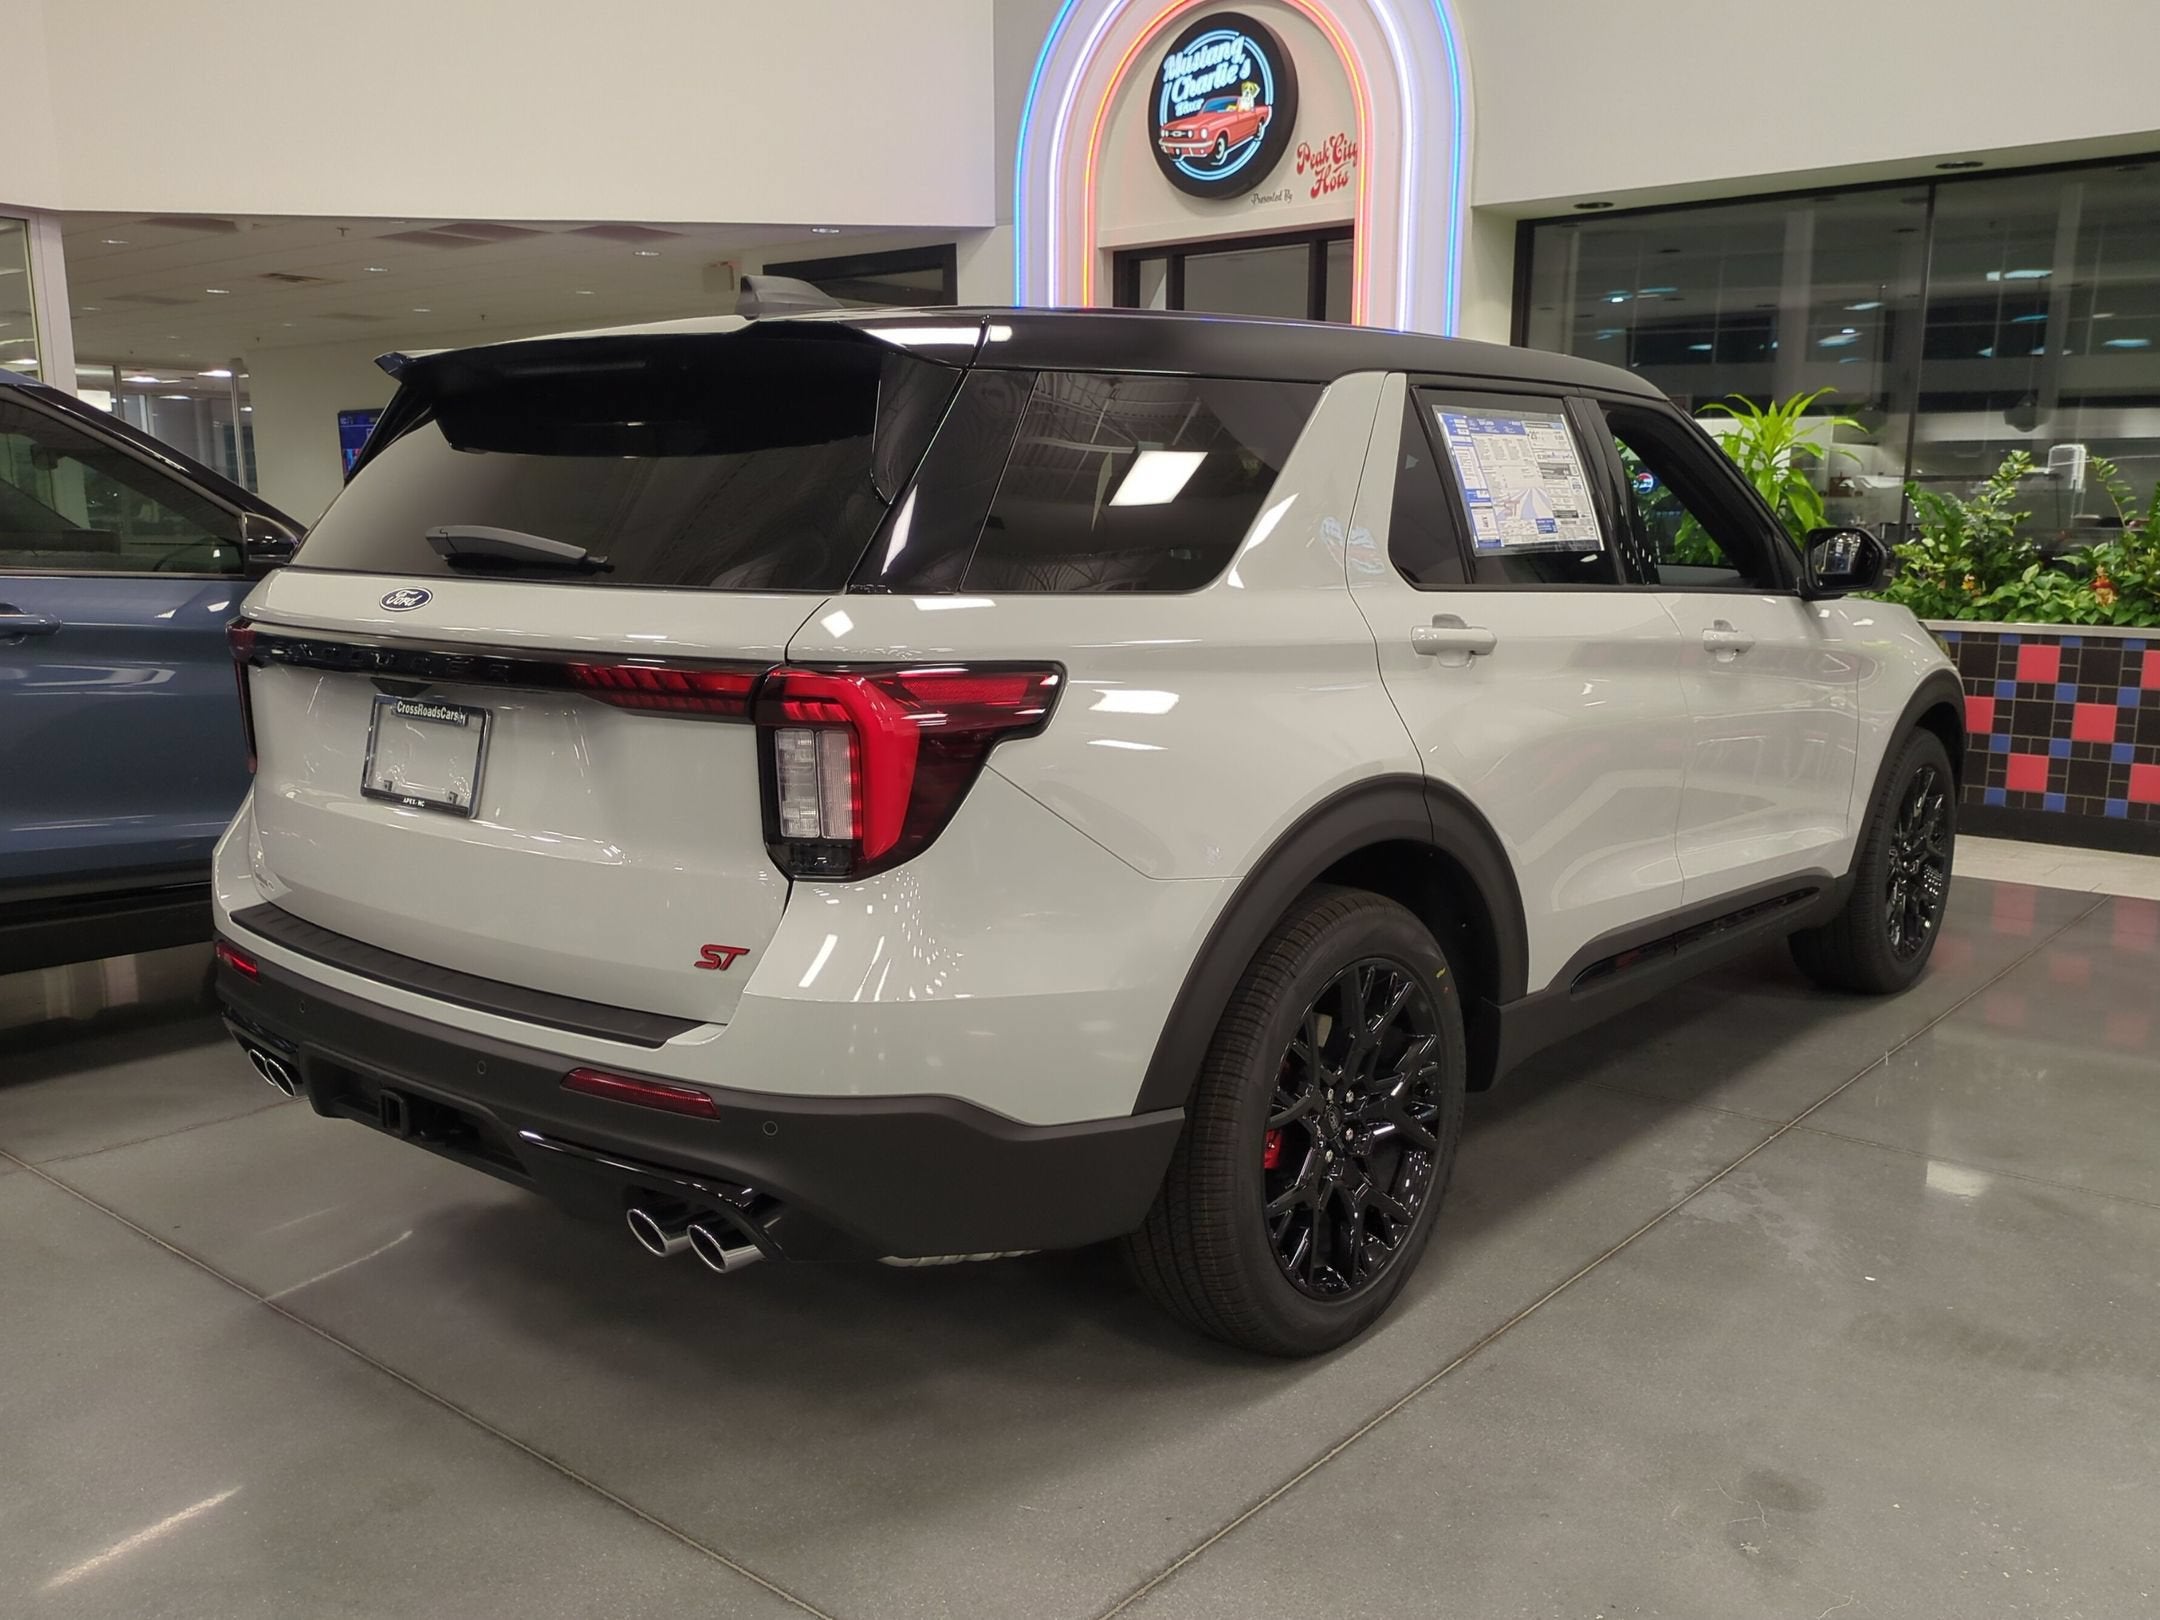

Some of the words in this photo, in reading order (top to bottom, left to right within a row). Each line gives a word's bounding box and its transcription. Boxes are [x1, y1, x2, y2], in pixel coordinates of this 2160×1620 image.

[1163, 36, 1245, 82] Mustang
[1171, 54, 1251, 103] Charlie's
[1297, 142, 1329, 174] Peak
[1330, 133, 1358, 167] City
[1284, 189, 1293, 204] By
[386, 590, 422, 606] Ford
[694, 944, 750, 971] ST
